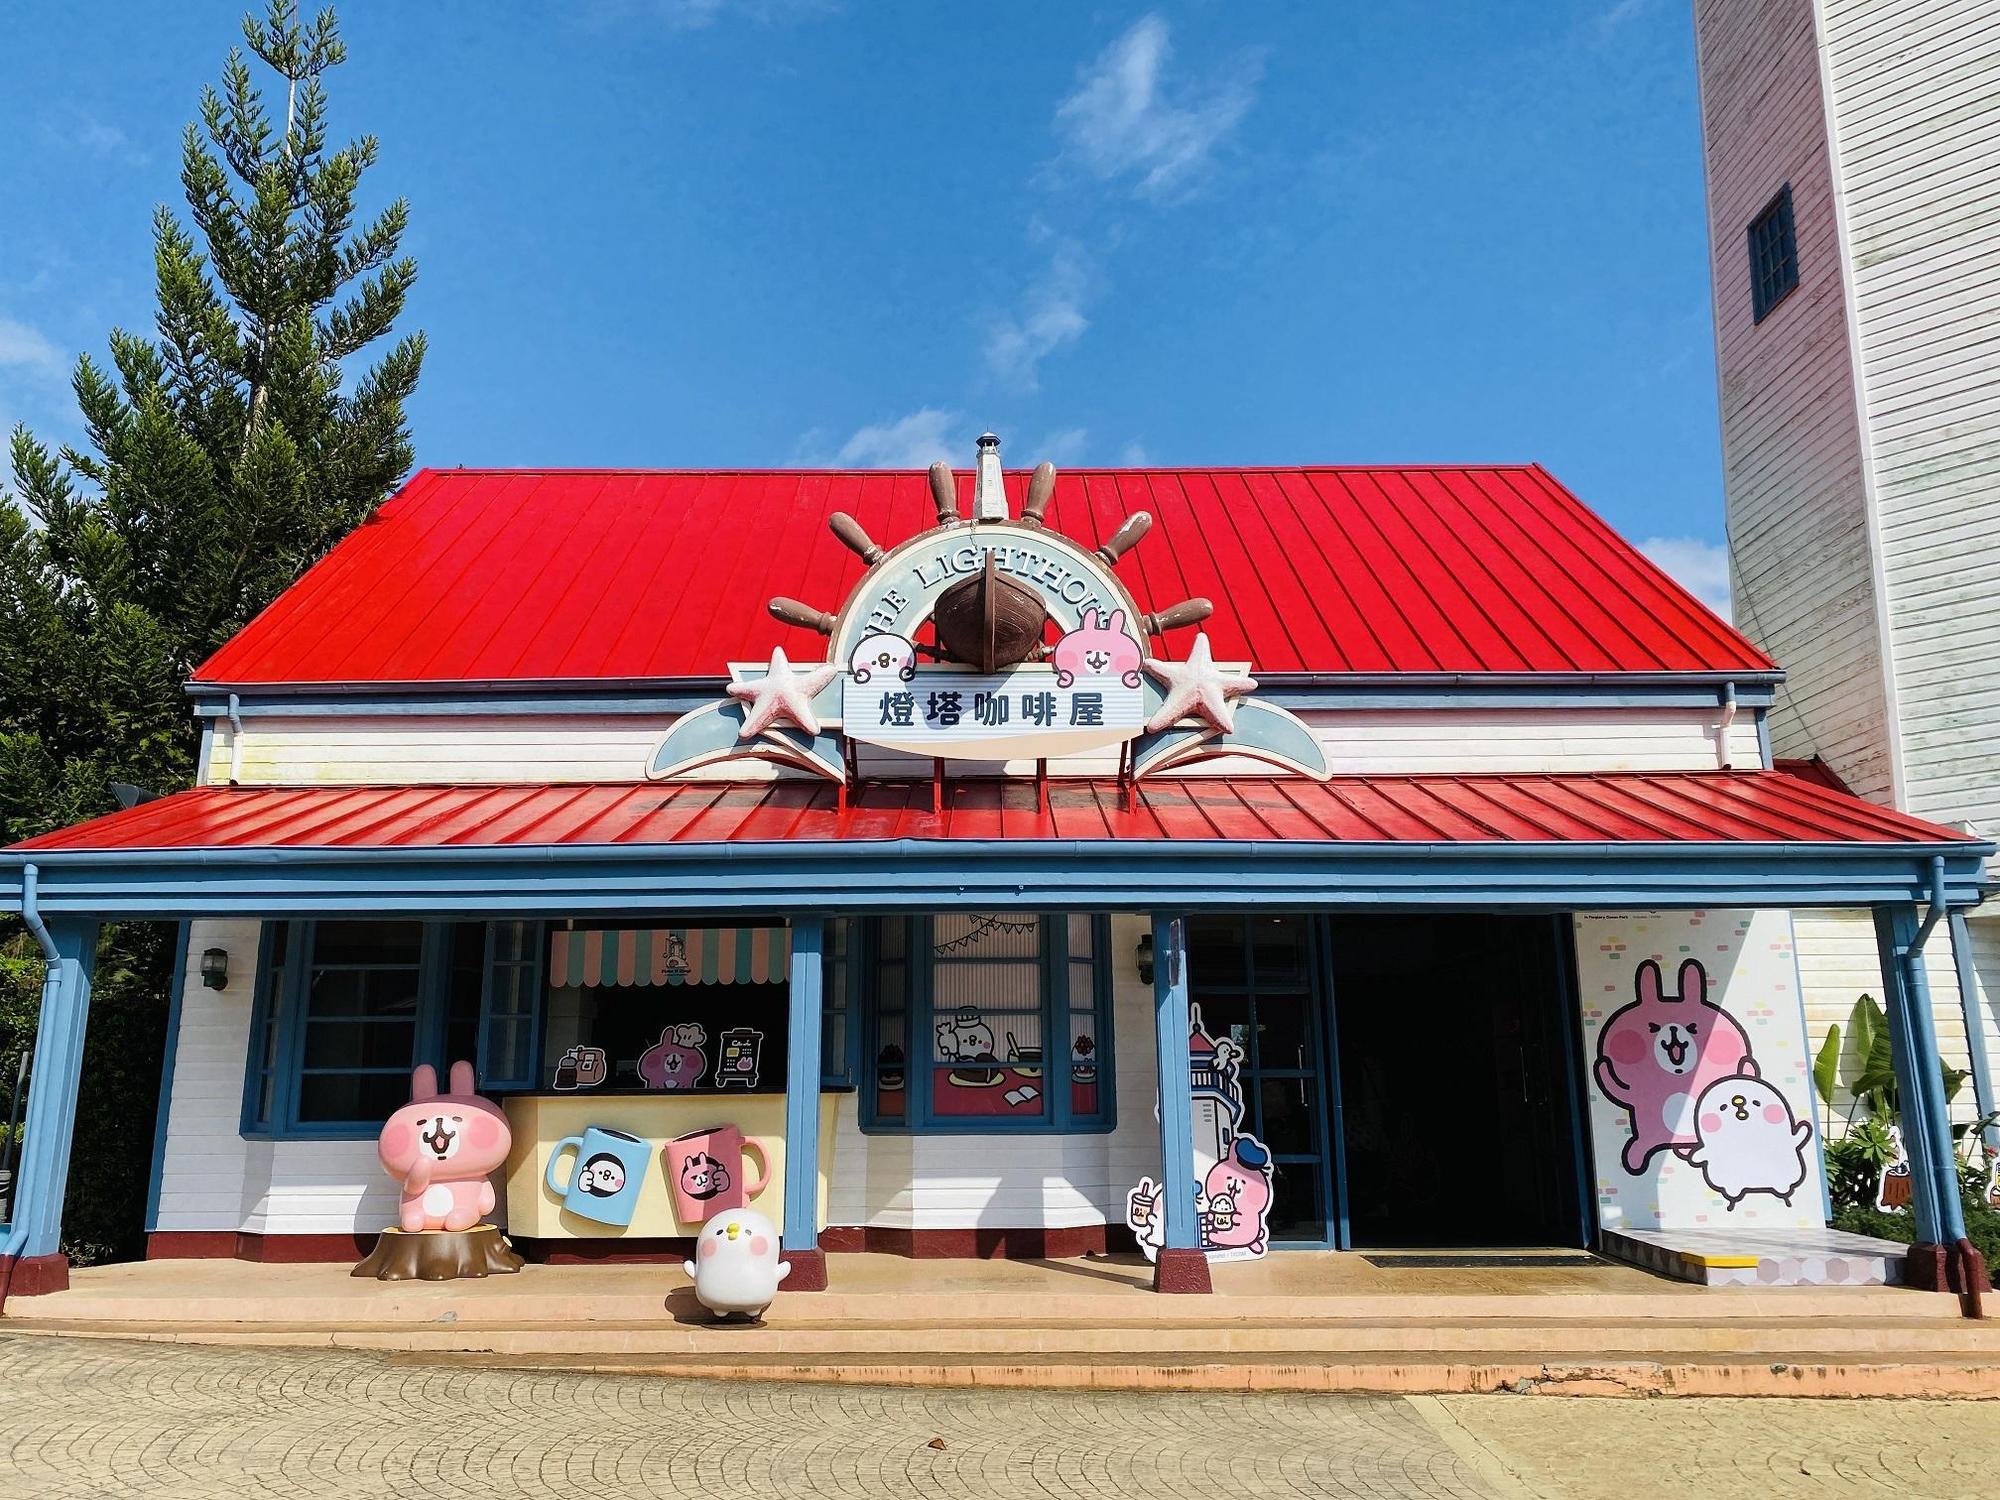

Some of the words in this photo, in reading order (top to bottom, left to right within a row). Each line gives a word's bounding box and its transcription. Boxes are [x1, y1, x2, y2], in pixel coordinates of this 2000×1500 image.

[879, 691, 1104, 726] 燈塔咖啡屋
